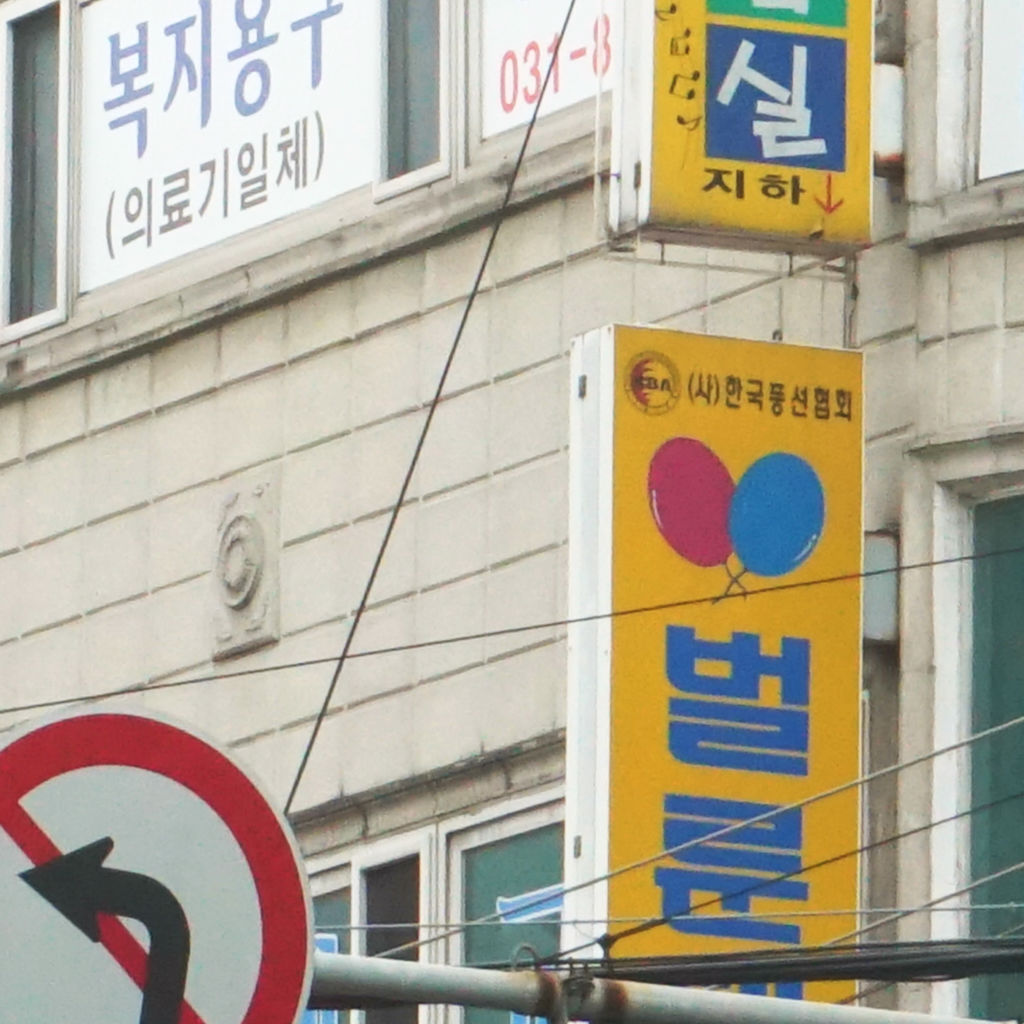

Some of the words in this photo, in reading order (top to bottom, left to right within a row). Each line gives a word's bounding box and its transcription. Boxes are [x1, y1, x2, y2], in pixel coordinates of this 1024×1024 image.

[105, 109, 326, 260] (의료기일체)
[702, 167, 806, 206] 지하
[653, 623, 811, 1001] 벌룬
